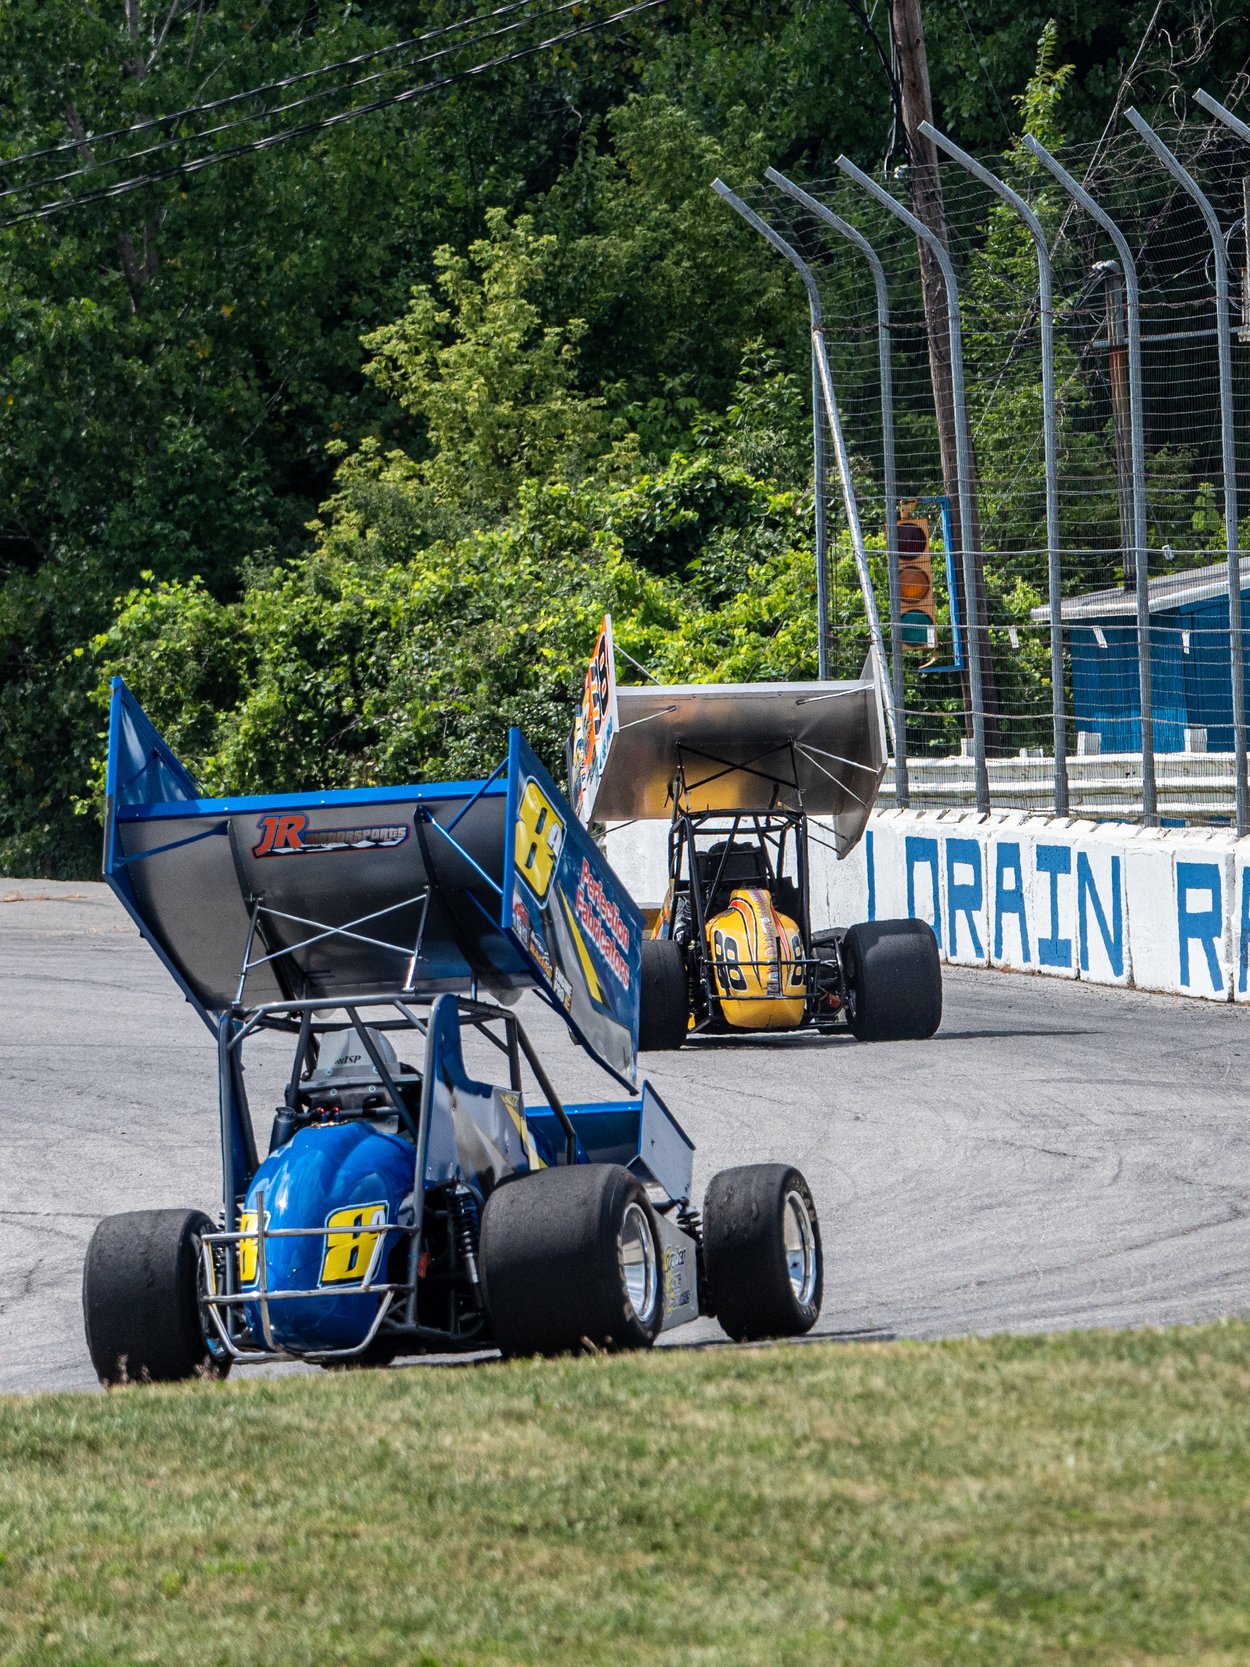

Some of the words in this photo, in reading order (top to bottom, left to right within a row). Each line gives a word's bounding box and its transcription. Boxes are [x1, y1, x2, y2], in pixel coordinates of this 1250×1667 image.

[256, 814, 307, 856] JR
[575, 886, 630, 991] Fabricators
[581, 856, 630, 955] Perfection
[343, 1055, 362, 1065] ISP
